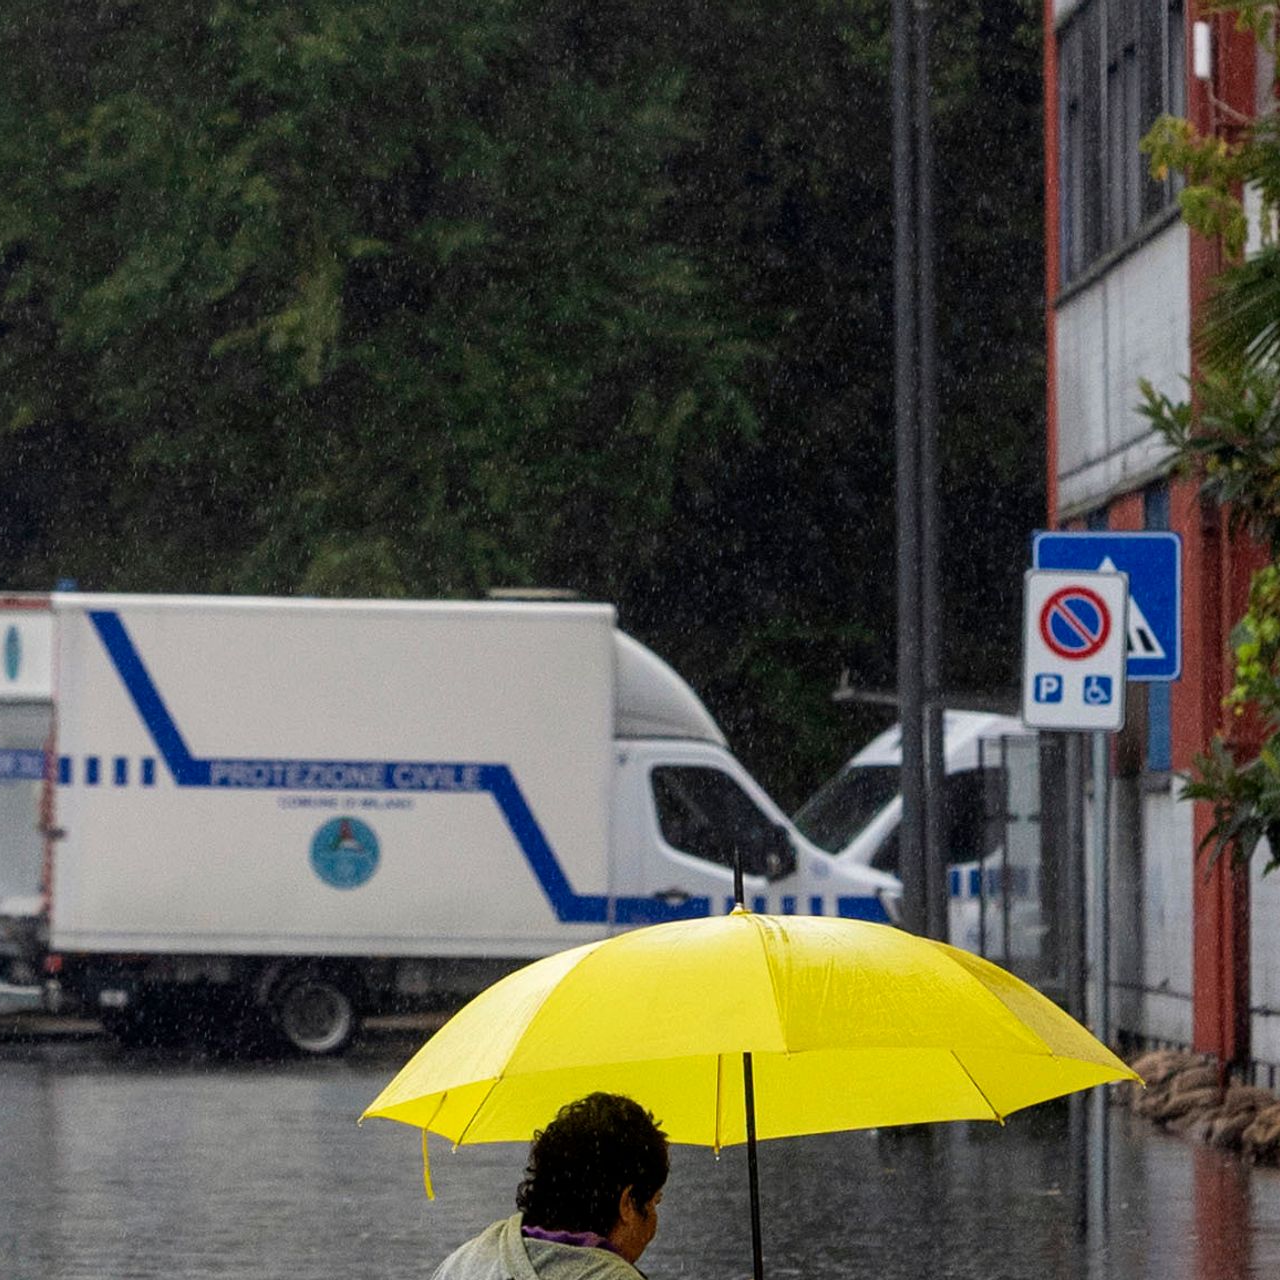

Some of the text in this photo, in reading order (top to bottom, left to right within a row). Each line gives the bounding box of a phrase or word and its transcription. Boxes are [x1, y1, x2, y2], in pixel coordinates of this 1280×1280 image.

[1040, 677, 1059, 700] P
[210, 762, 479, 790] PROTEZIONE CIVILE
